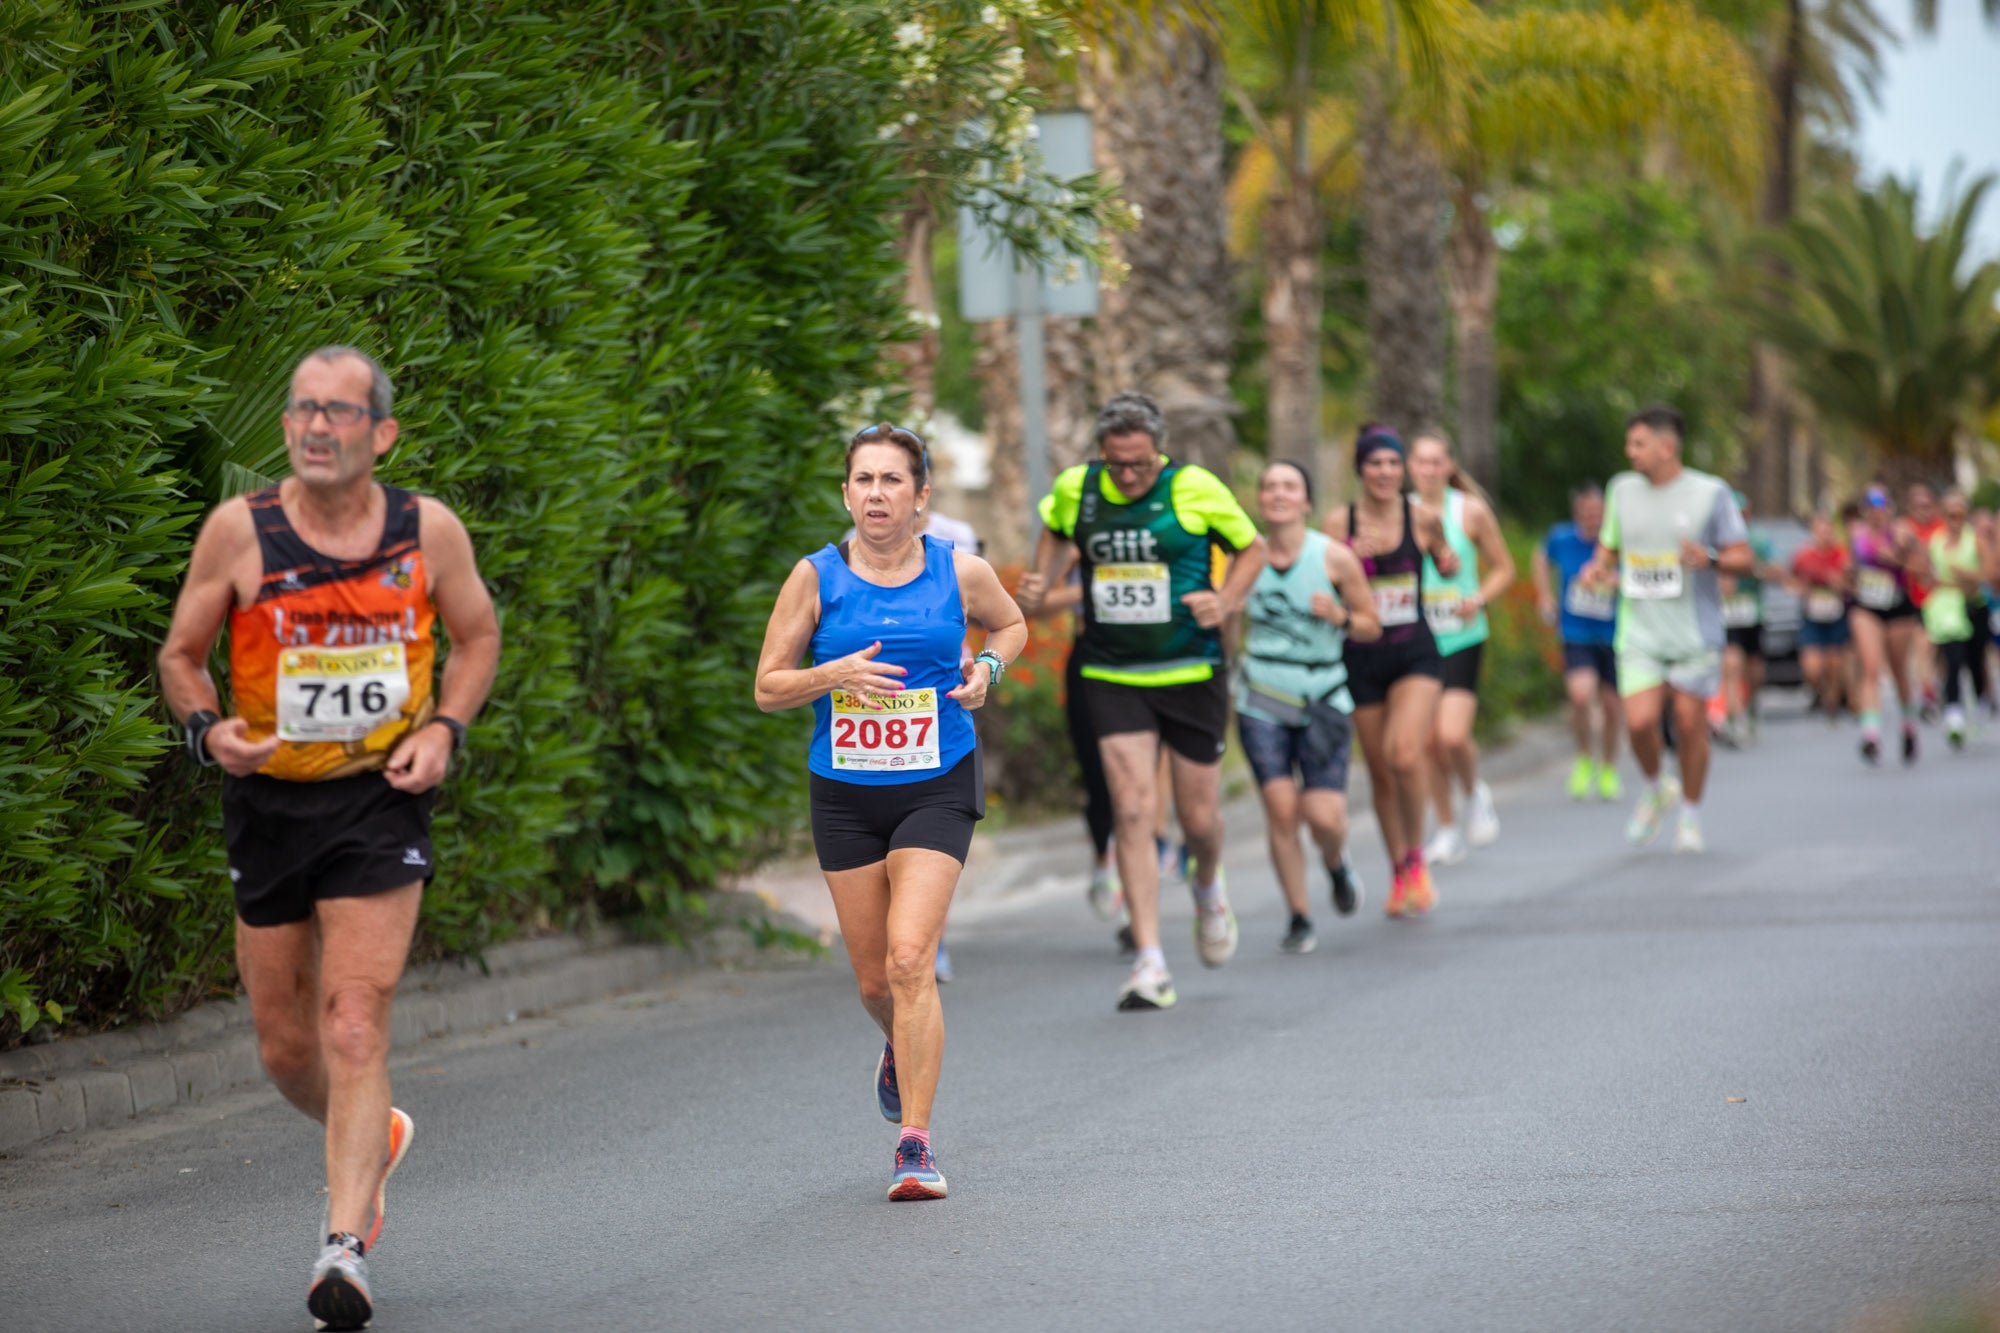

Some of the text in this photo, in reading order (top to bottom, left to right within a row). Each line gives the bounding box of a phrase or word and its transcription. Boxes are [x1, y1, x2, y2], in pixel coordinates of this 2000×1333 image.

[1086, 529, 1159, 563] Giit
[1106, 585, 1156, 607] 353
[298, 682, 388, 717] 716
[845, 694, 861, 708] 38
[835, 717, 933, 749] 2087
